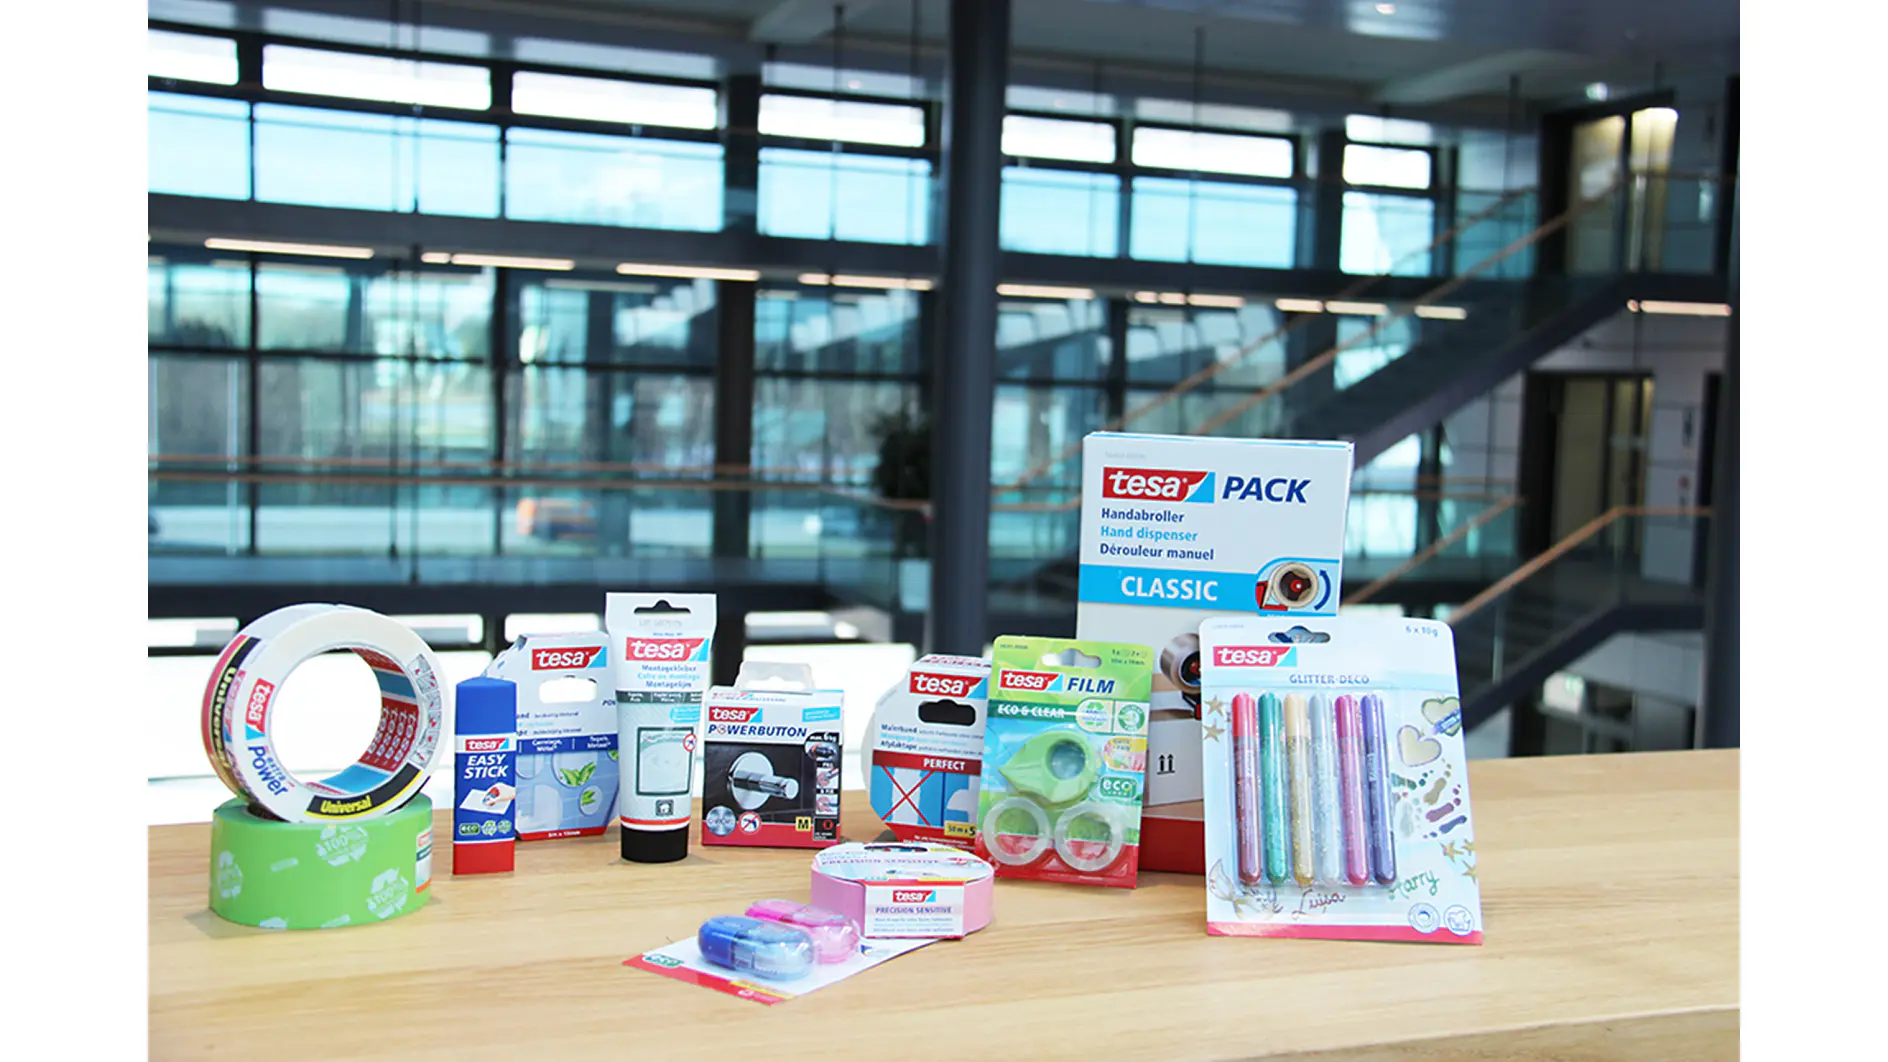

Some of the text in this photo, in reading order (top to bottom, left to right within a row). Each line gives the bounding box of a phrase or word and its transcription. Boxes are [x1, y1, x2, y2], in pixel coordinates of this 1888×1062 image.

[1108, 470, 1311, 504] tesa PACK
[1101, 508, 1185, 523] Handabroller
[1100, 526, 1199, 543] Hand dispenser
[1100, 543, 1214, 561] Dérouleur manuel
[1121, 576, 1219, 601] CLASSIC
[631, 640, 687, 658] tesa
[1218, 647, 1272, 665] tesa
[535, 650, 584, 668] tesa
[914, 674, 964, 695] tesa
[1003, 671, 1115, 694] tesa FILM
[248, 683, 271, 722] tesa
[711, 708, 747, 720] tesa
[997, 704, 1017, 716] ECO
[1031, 706, 1065, 719] CLEAR
[468, 740, 497, 750] tesa
[467, 753, 506, 767] EASY
[923, 758, 966, 770] PERFECT
[248, 745, 289, 796] Power
[463, 766, 509, 779] STICK
[1102, 779, 1132, 793] eco
[320, 795, 372, 814] Universal
[798, 818, 809, 830] M
[894, 891, 924, 902] tesa
[875, 906, 952, 914] PRECISION SENSITIVE
